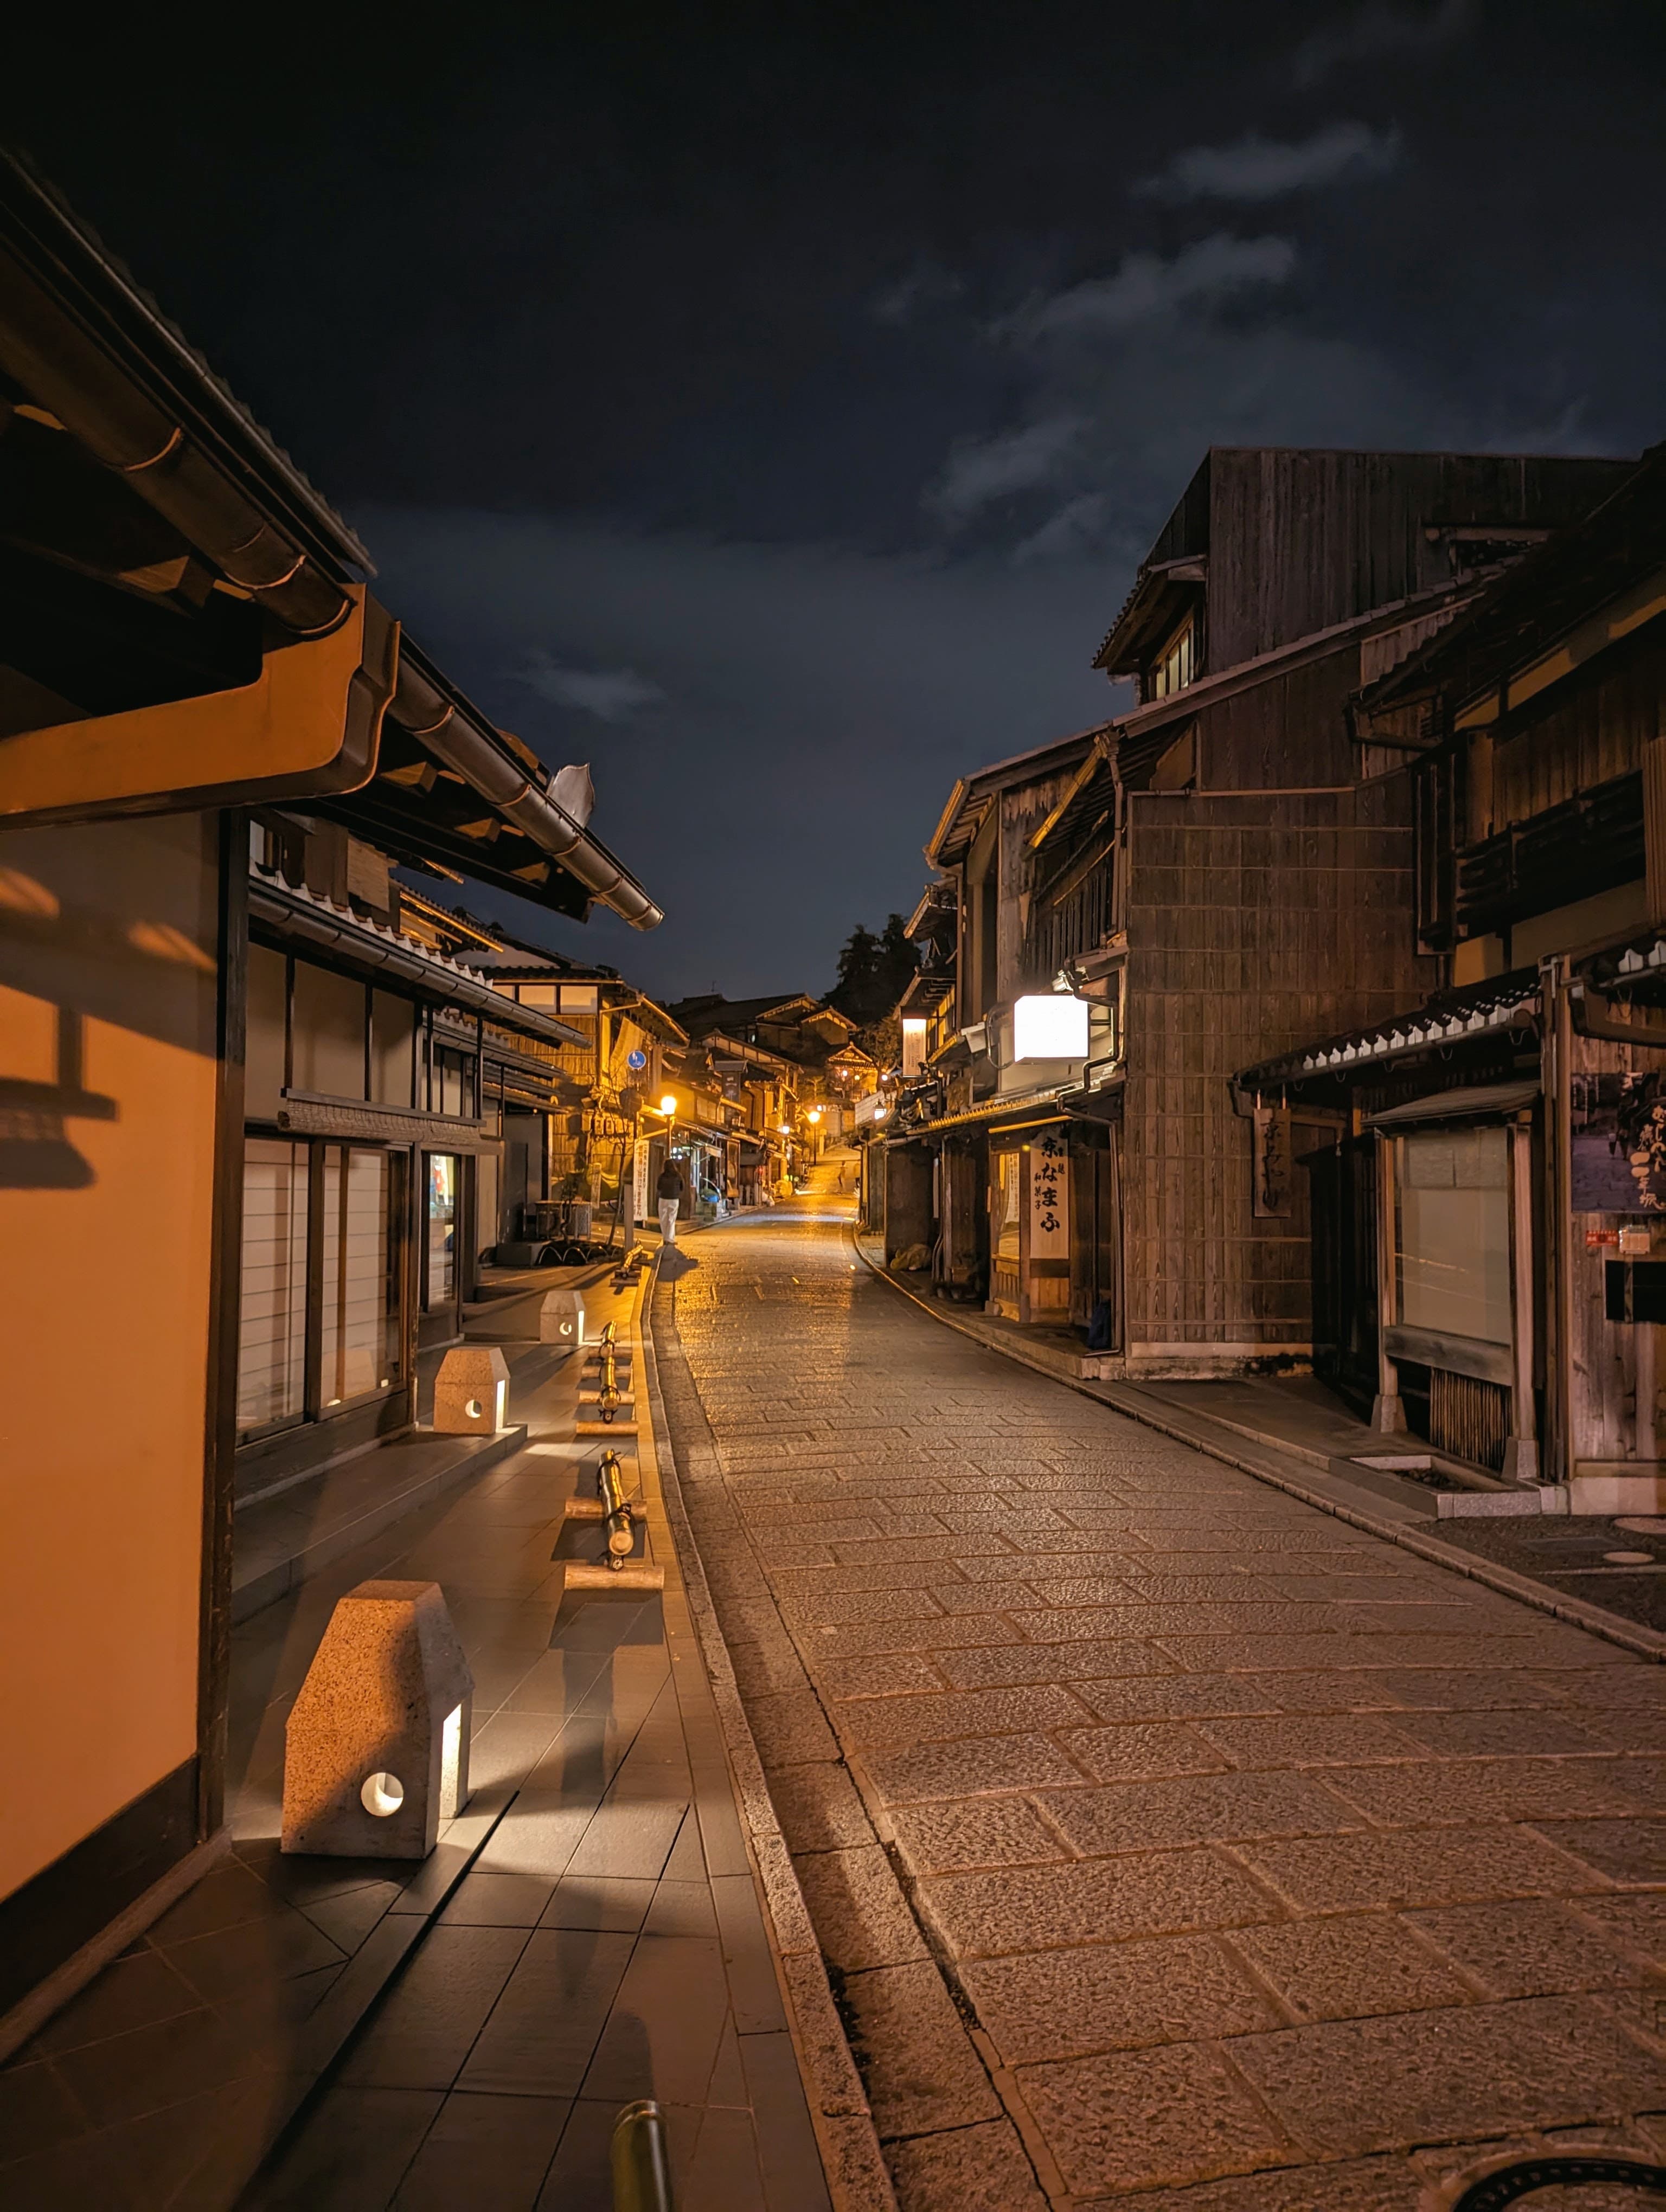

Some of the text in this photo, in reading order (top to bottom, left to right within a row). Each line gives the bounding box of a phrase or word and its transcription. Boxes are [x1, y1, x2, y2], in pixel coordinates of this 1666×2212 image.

[1034, 1172, 1042, 1210] 和菓子
[1040, 1136, 1060, 1232] 京なまふ
